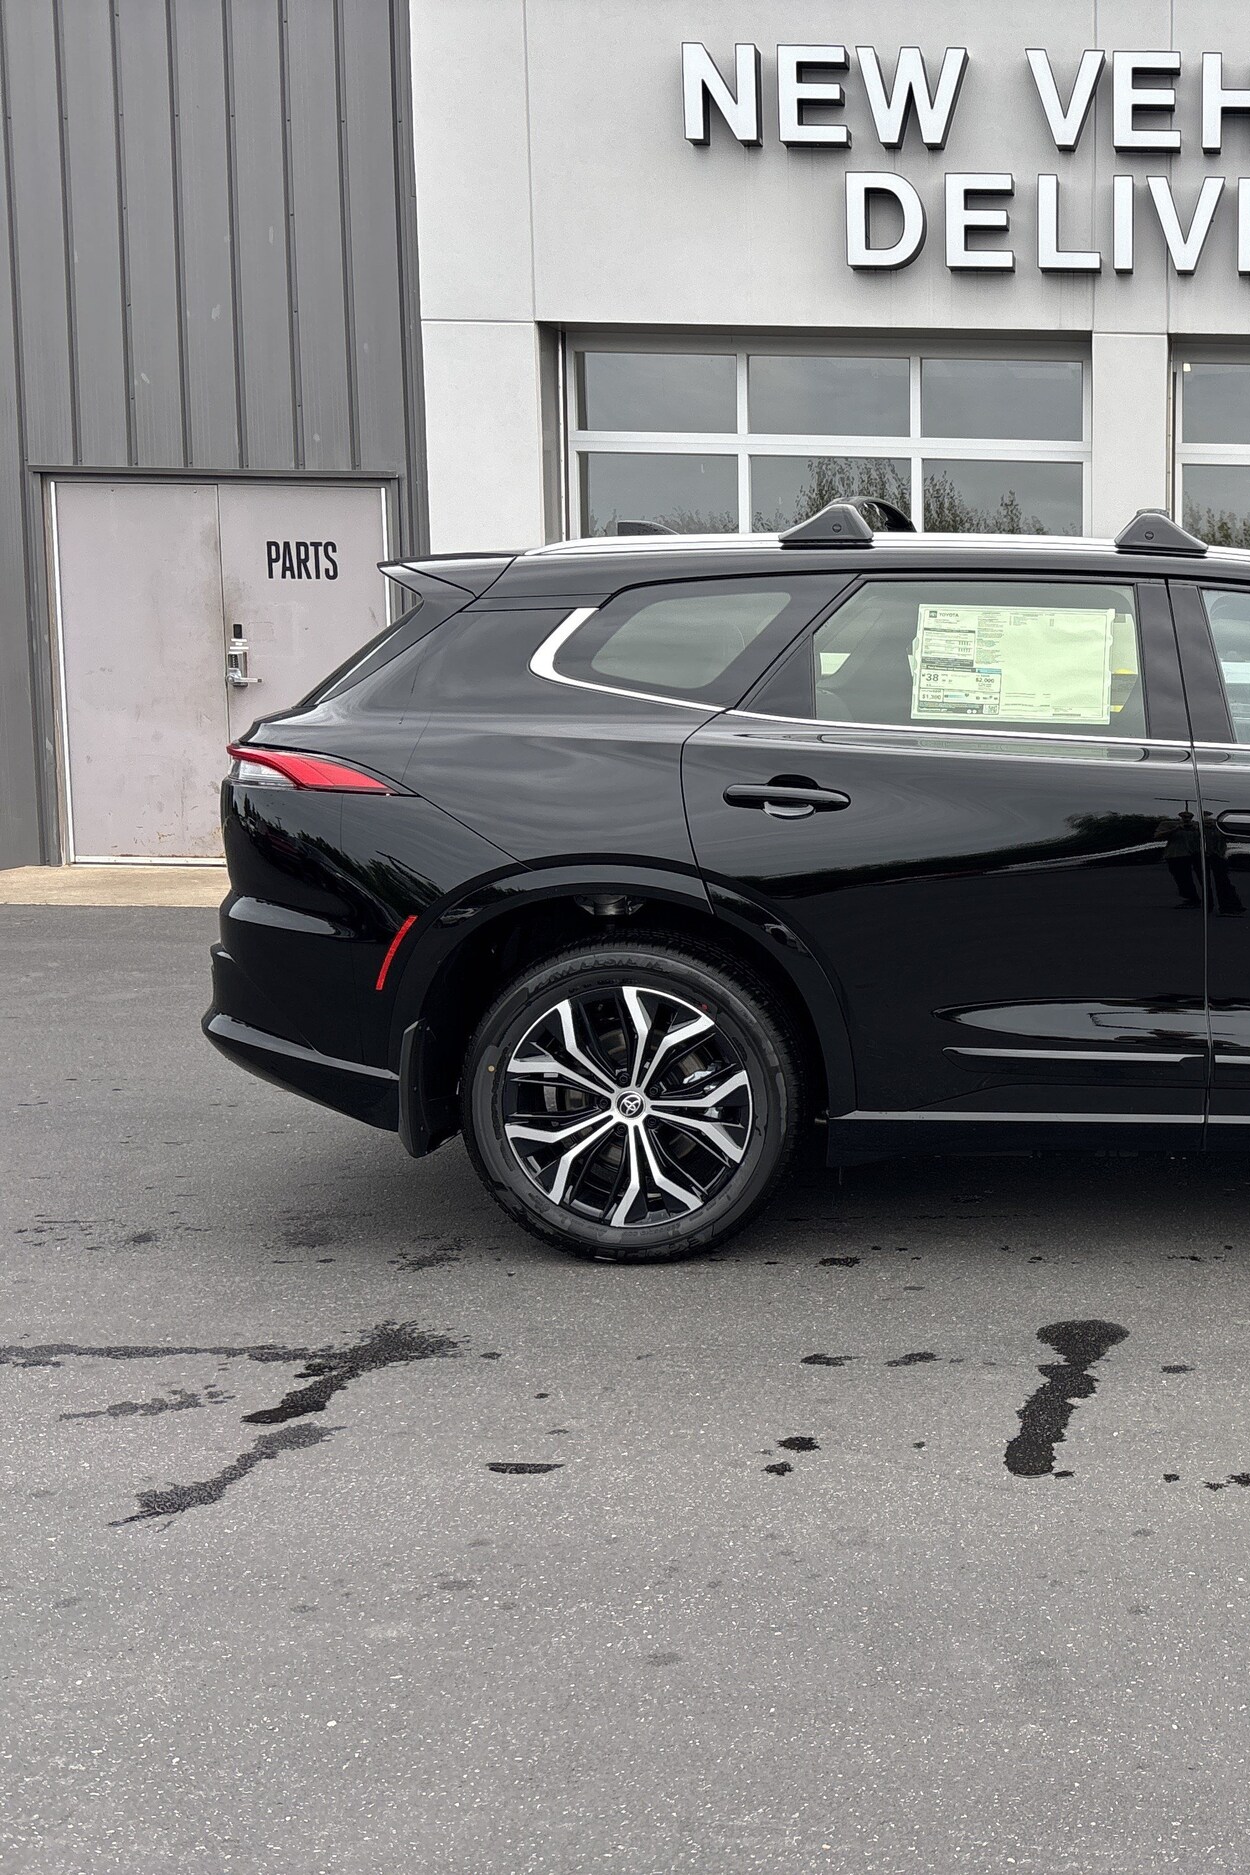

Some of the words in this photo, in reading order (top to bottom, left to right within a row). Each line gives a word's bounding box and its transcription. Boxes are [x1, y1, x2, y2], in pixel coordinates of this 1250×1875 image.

[681, 42, 968, 150] NEW
[266, 541, 339, 580] PARTS
[926, 673, 939, 682] 38
